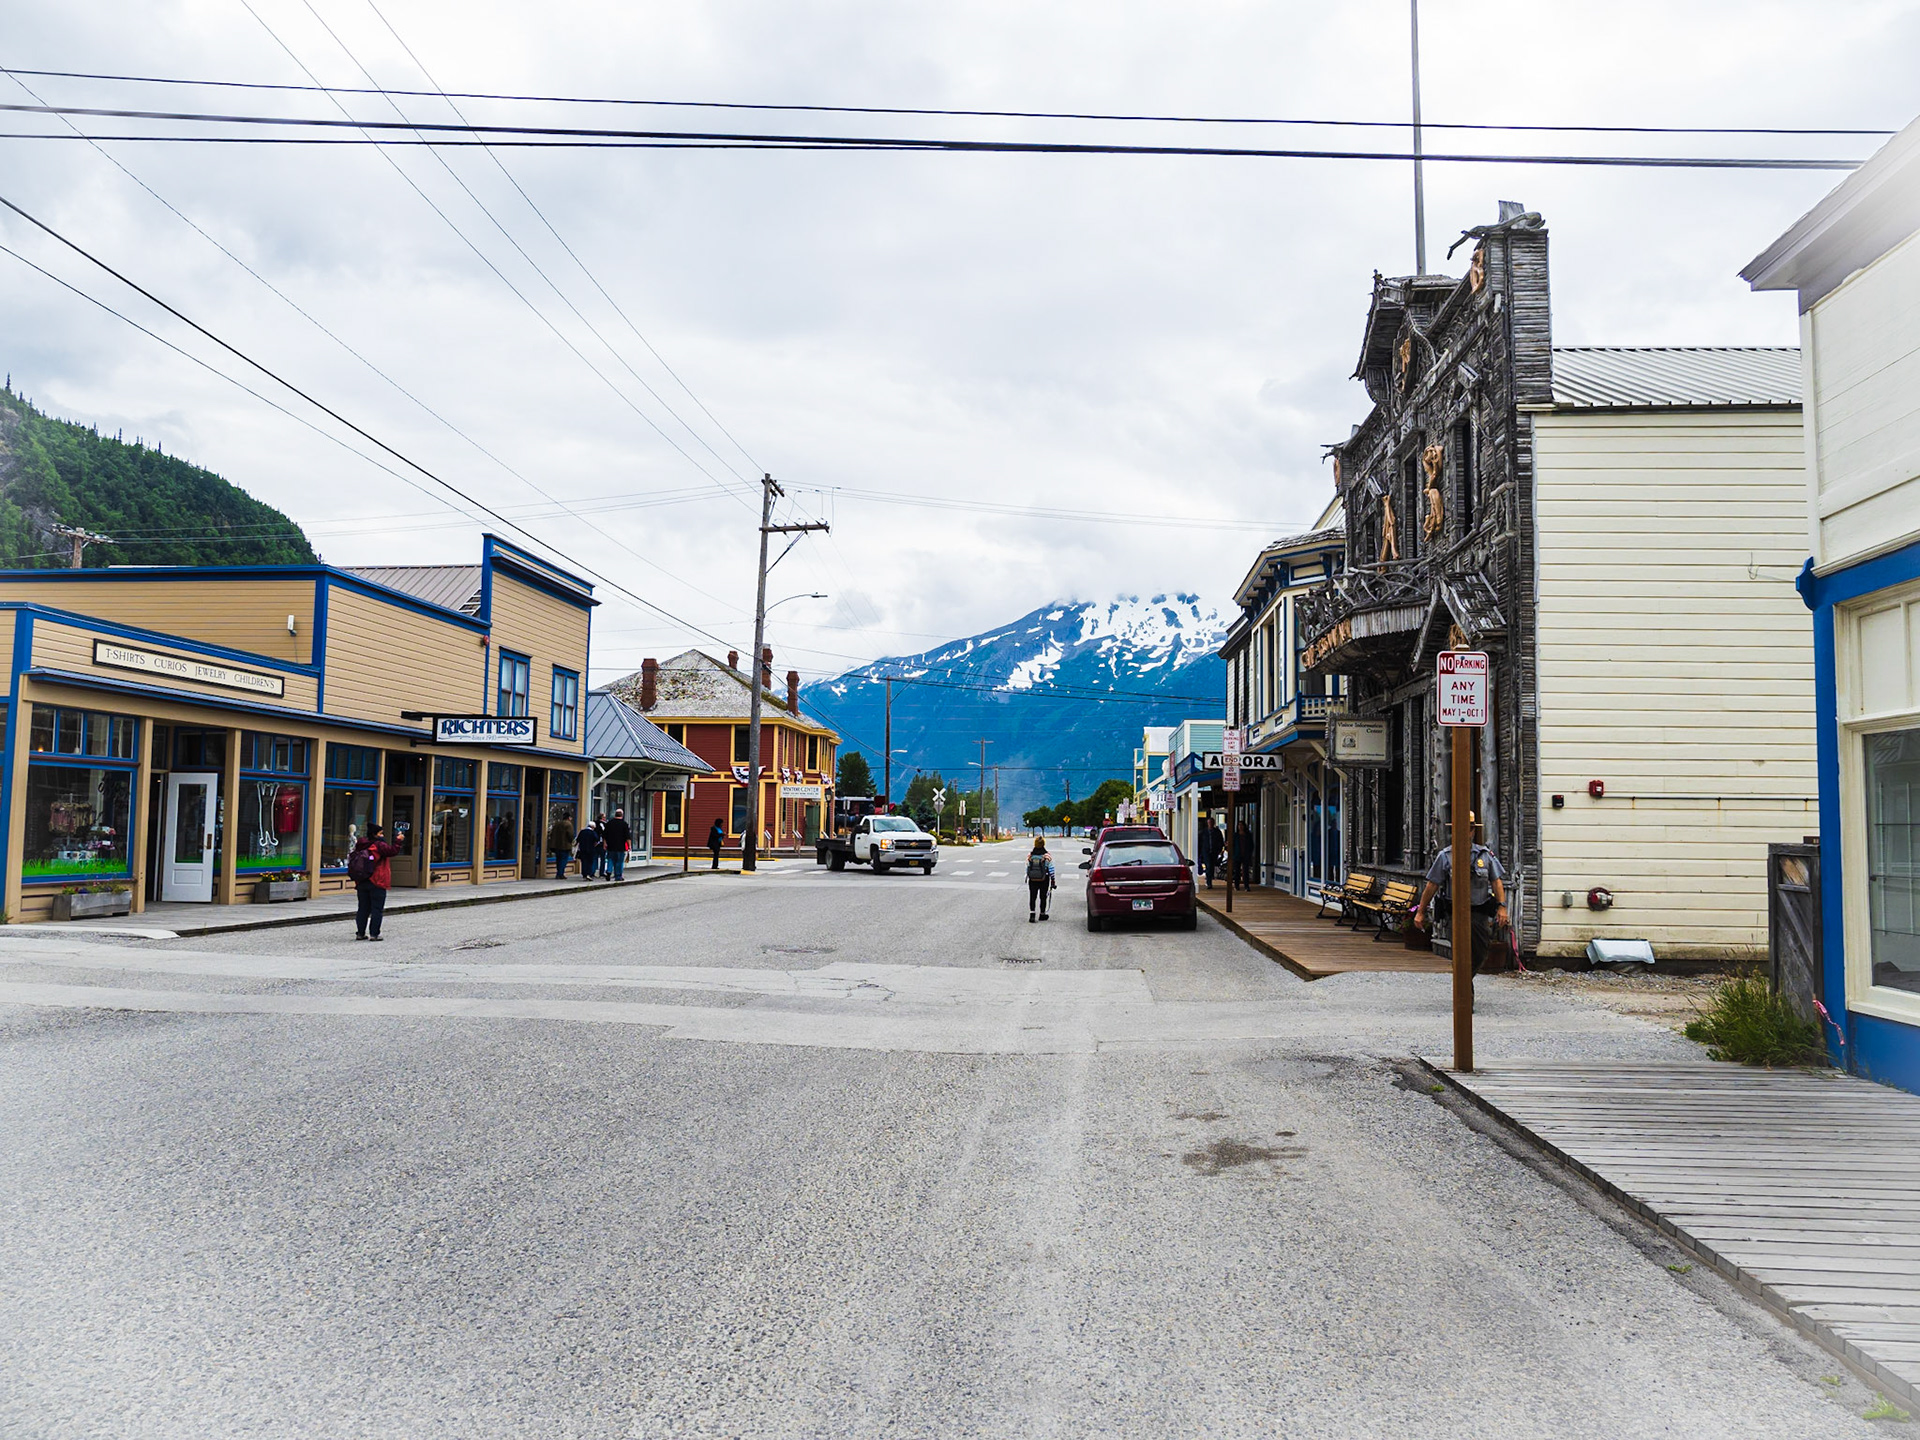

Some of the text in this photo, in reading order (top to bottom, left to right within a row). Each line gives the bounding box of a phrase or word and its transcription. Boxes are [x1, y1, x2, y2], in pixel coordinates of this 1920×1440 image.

[105, 648, 275, 689] T-SHIRTS CURIOS JEWELRY CHILDREN'S
[1440, 657, 1485, 671] NO PARKING
[1451, 681, 1475, 691] ANY
[1451, 694, 1476, 705] TIME
[1442, 708, 1456, 716] MAY
[440, 718, 530, 736] RICHTERS
